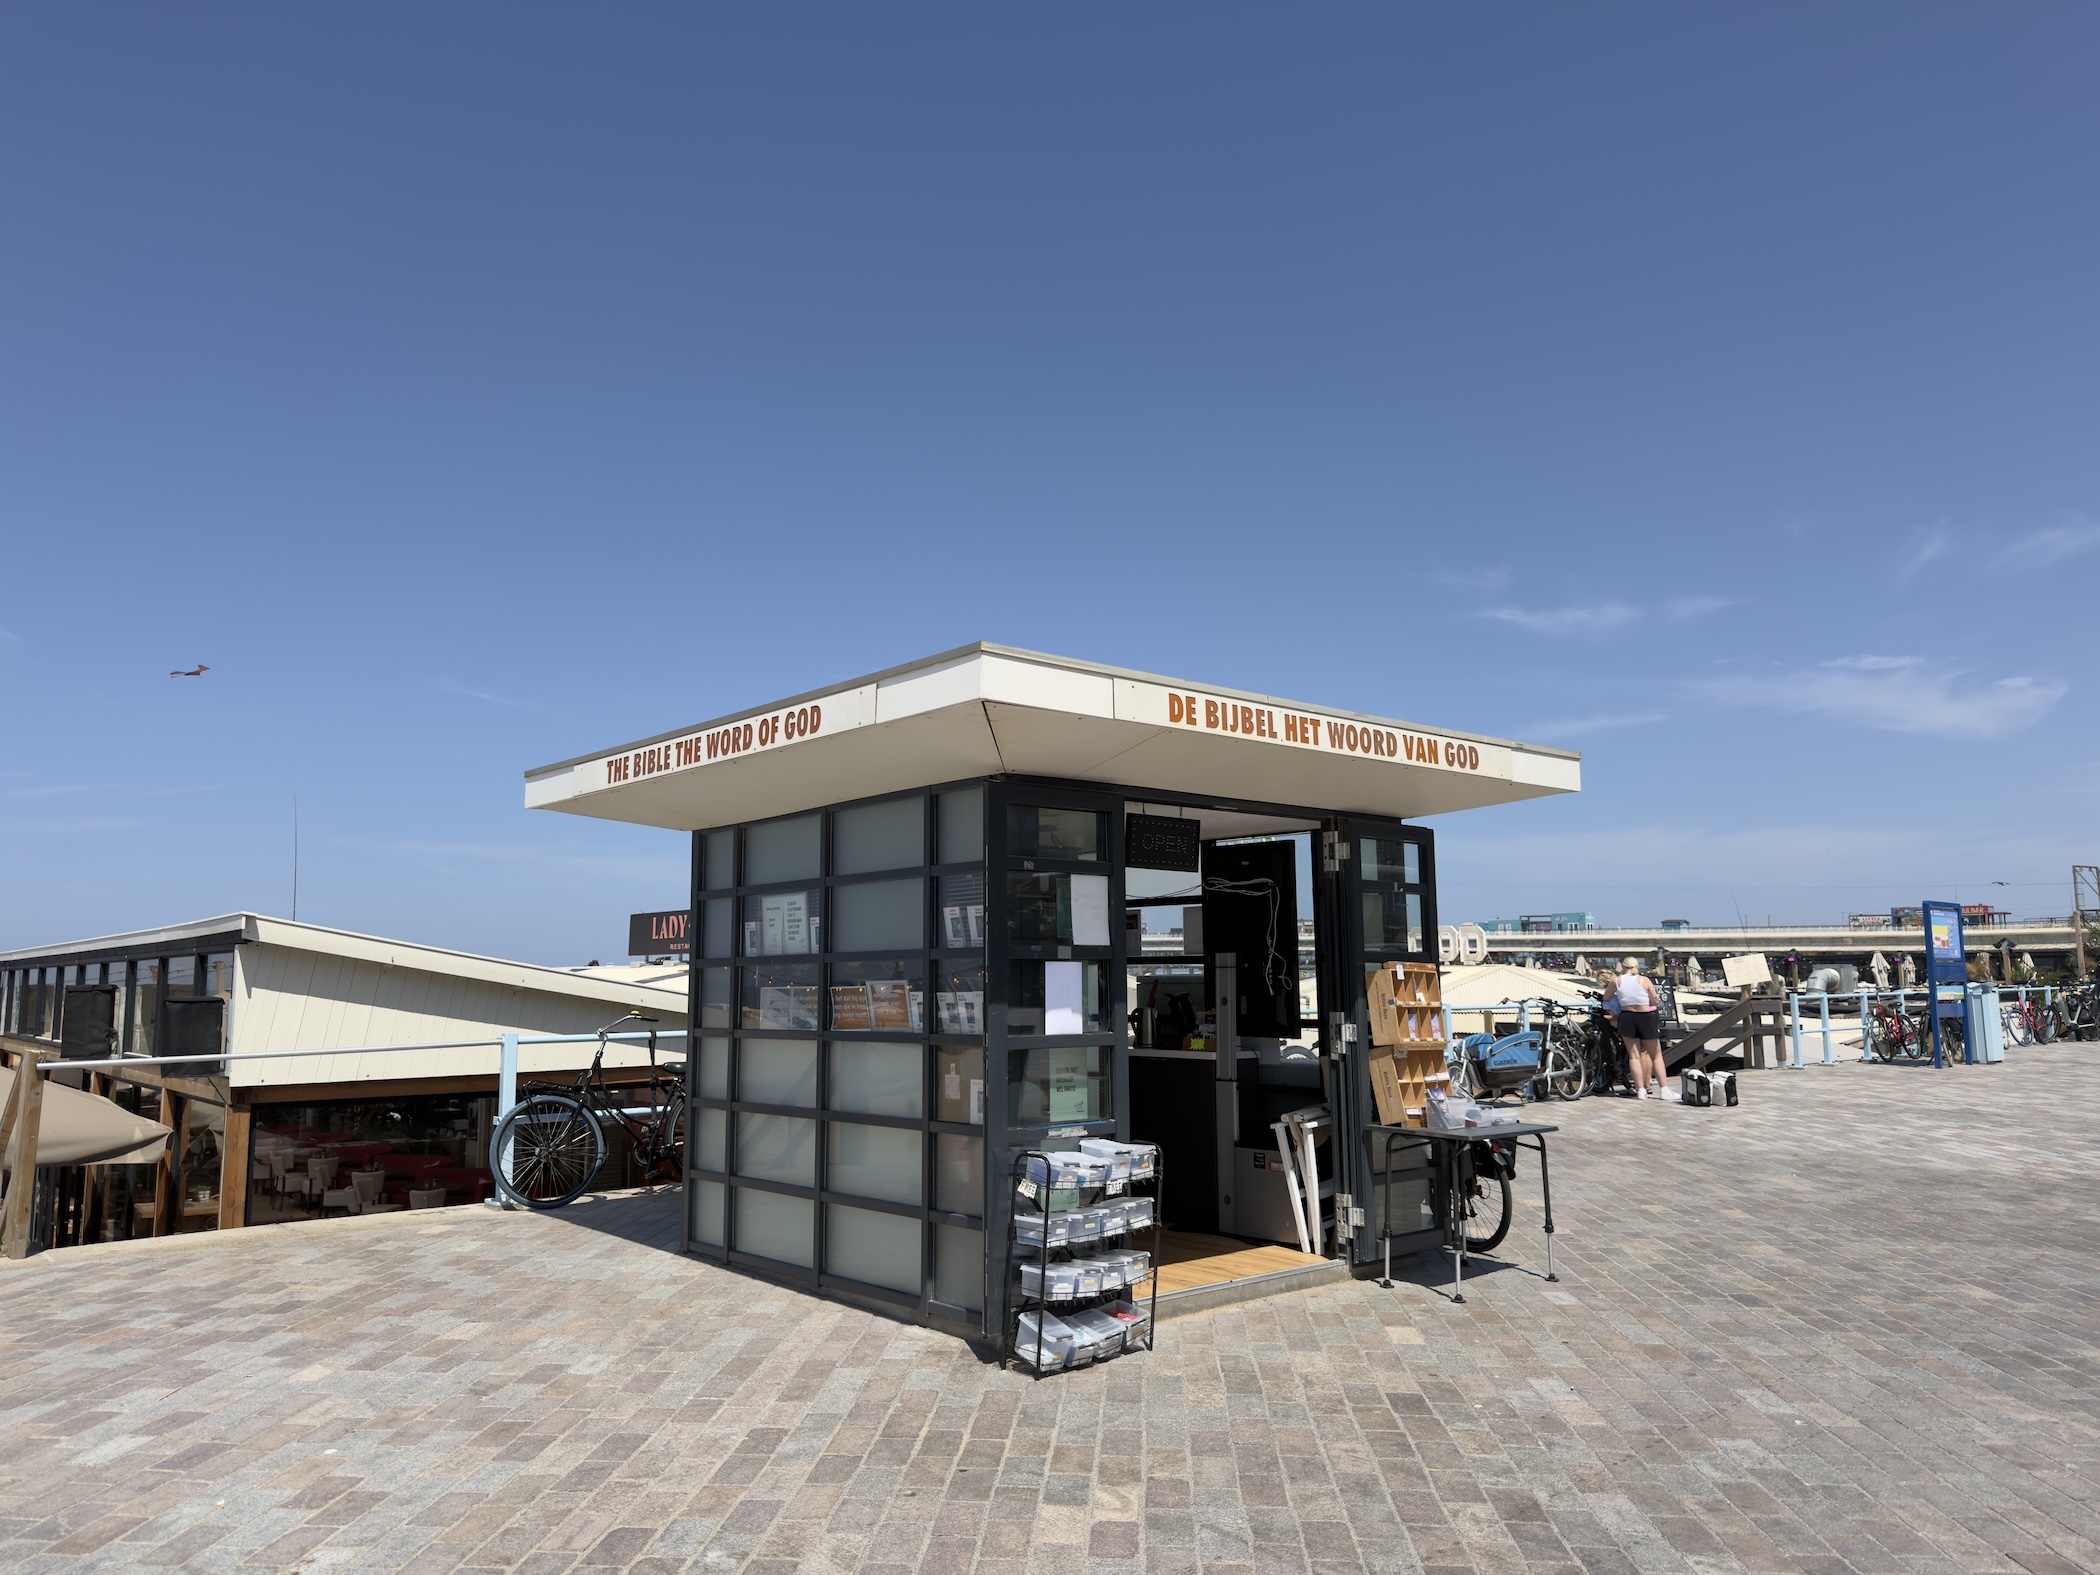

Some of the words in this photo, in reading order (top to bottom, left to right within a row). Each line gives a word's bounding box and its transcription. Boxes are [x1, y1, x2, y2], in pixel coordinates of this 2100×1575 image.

[1168, 693, 1197, 726] DE
[1205, 699, 1278, 739] BIJBEL
[1284, 713, 1321, 746] HET
[1326, 721, 1398, 758] WOORD
[1402, 734, 1439, 765] VAN
[1444, 741, 1480, 770] GOD
[606, 756, 630, 784] THE
[633, 744, 671, 778] BIBLE
[675, 736, 702, 767] THE
[706, 723, 753, 760] WORD
[758, 715, 779, 747] OF
[784, 705, 822, 740] GOD
[1141, 833, 1187, 853] OPEN
[651, 914, 688, 940] LADY
[1493, 1057, 1518, 1066] Gazelle
[1019, 1181, 1036, 1196] FREE
[1107, 1180, 1123, 1193] FREE
